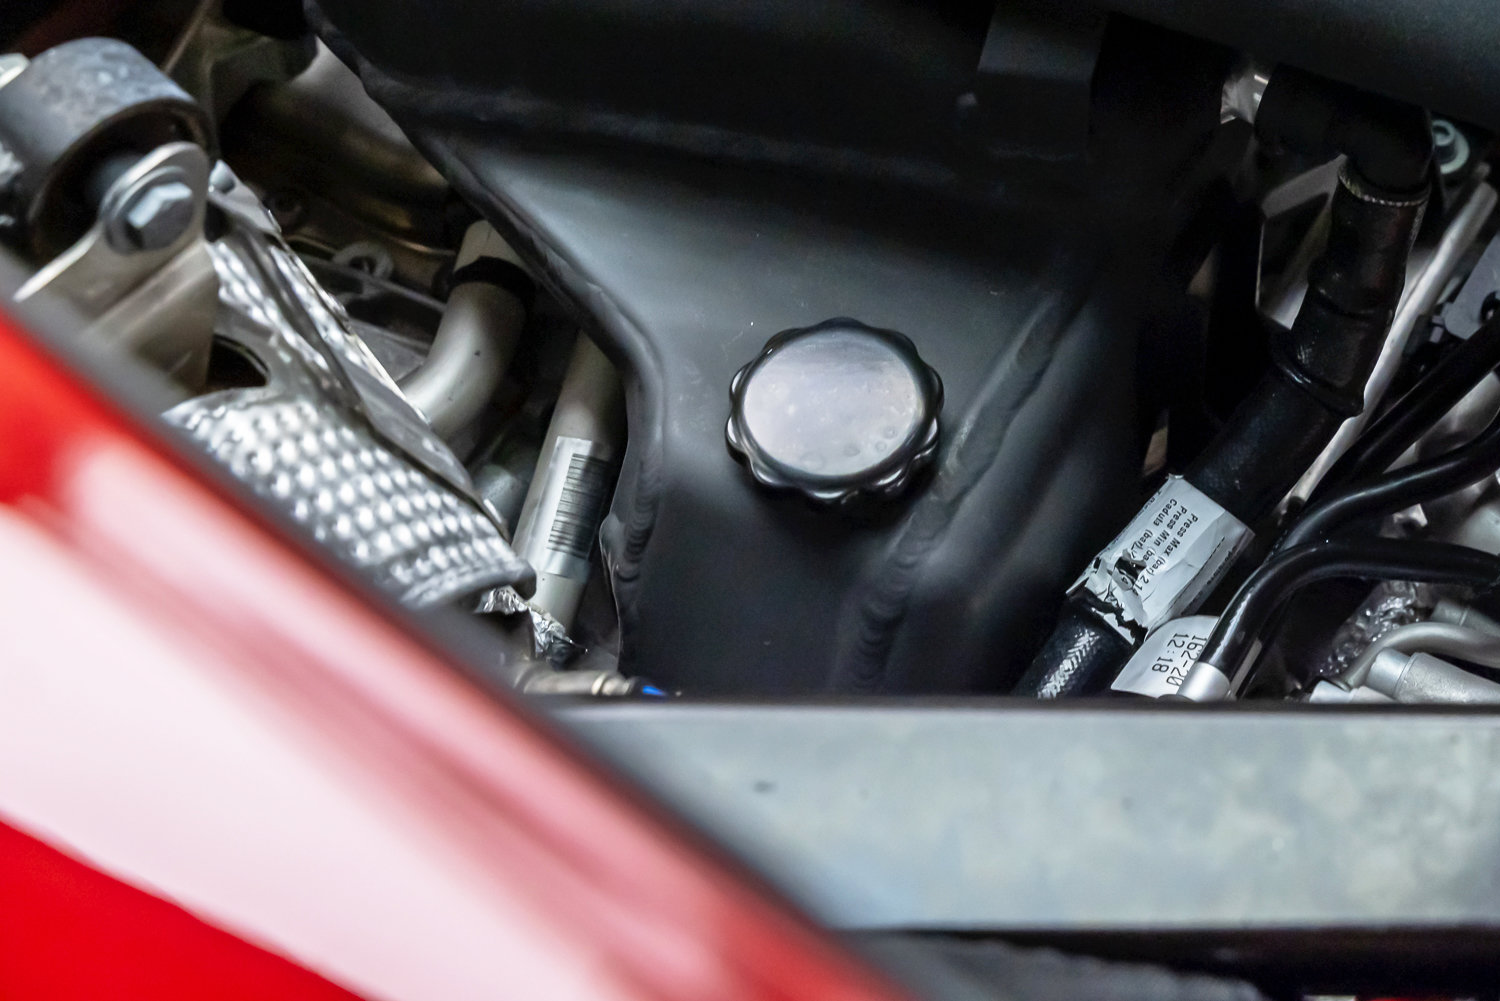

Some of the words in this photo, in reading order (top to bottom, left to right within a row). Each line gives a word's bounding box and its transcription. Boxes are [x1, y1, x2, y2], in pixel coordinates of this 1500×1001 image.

[1167, 505, 1188, 529] Press
[1177, 513, 1199, 538] Press
[1154, 529, 1170, 547] Min
[1164, 537, 1181, 557] Max
[1146, 556, 1166, 576] (bar)
[1166, 635, 1208, 687] 162-20
